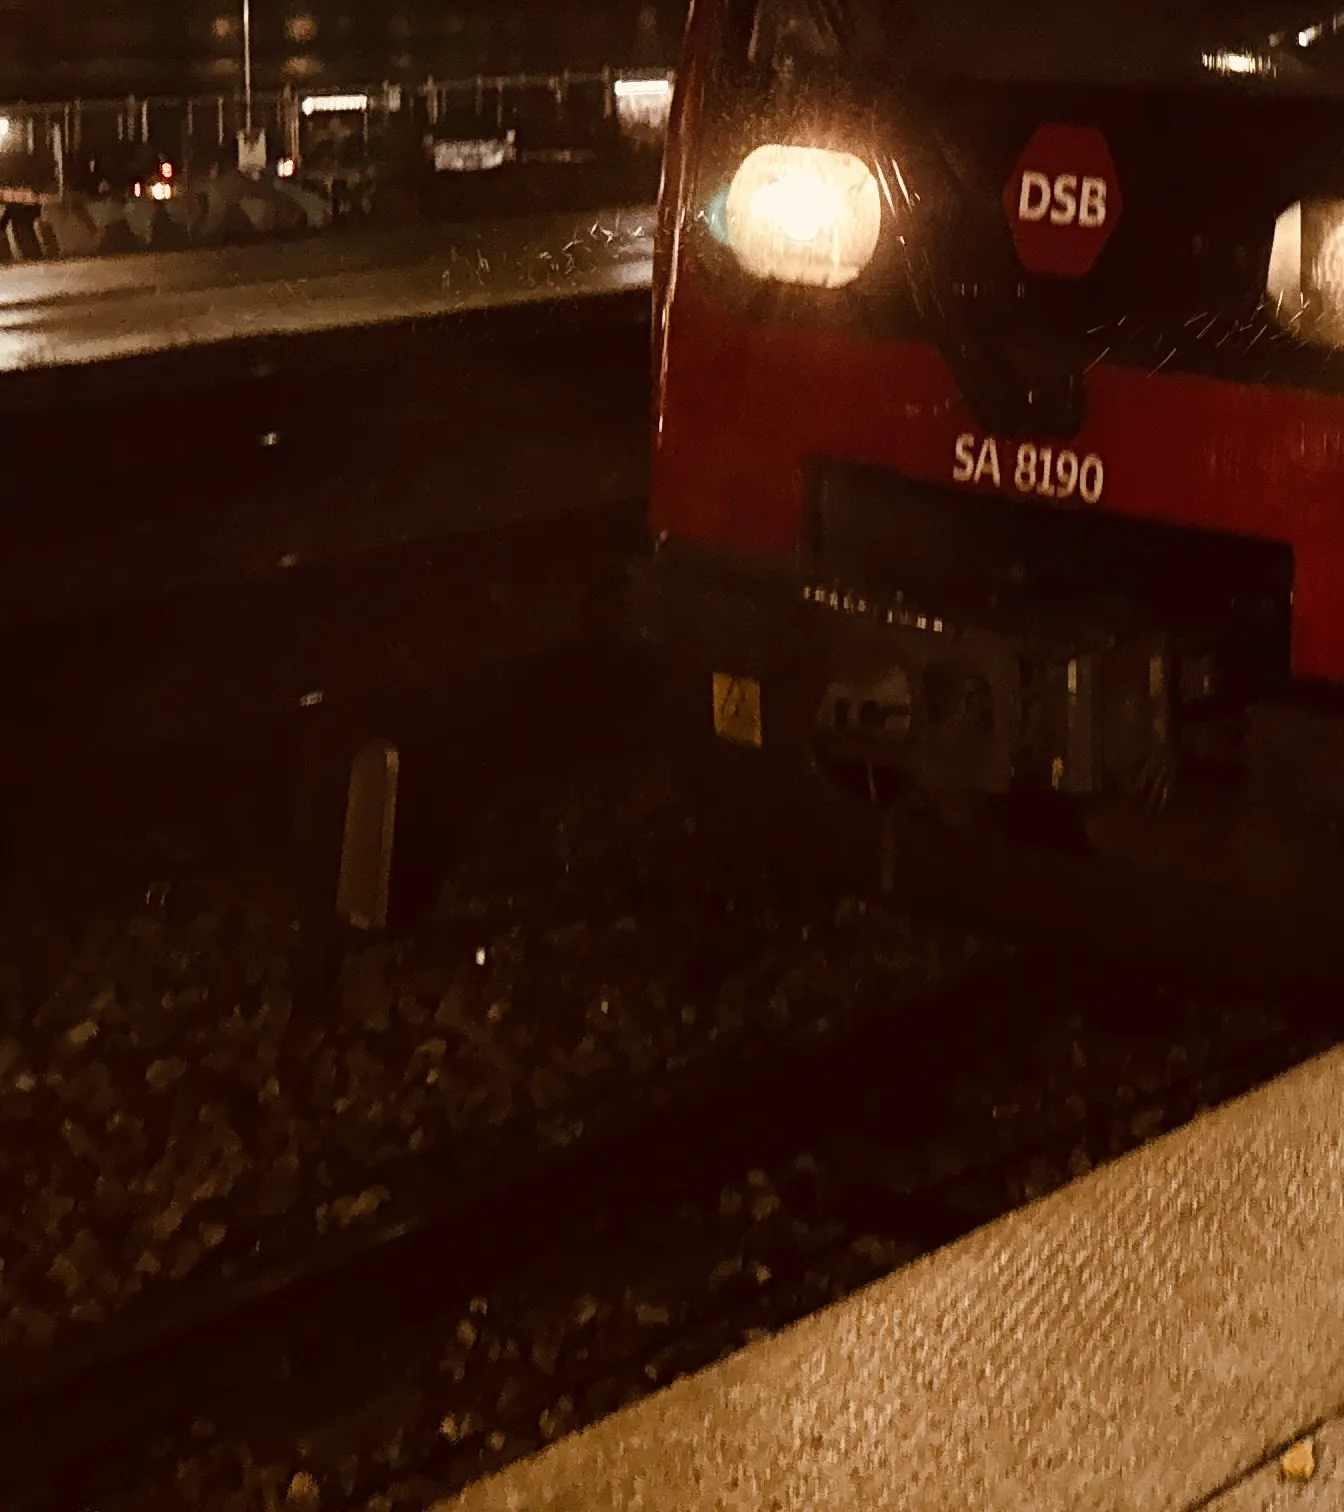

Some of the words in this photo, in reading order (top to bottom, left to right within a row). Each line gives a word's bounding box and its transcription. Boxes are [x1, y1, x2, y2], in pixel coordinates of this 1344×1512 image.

[1018, 170, 1107, 228] DSB
[953, 432, 1001, 488] SA
[1014, 442, 1104, 504] 8190
